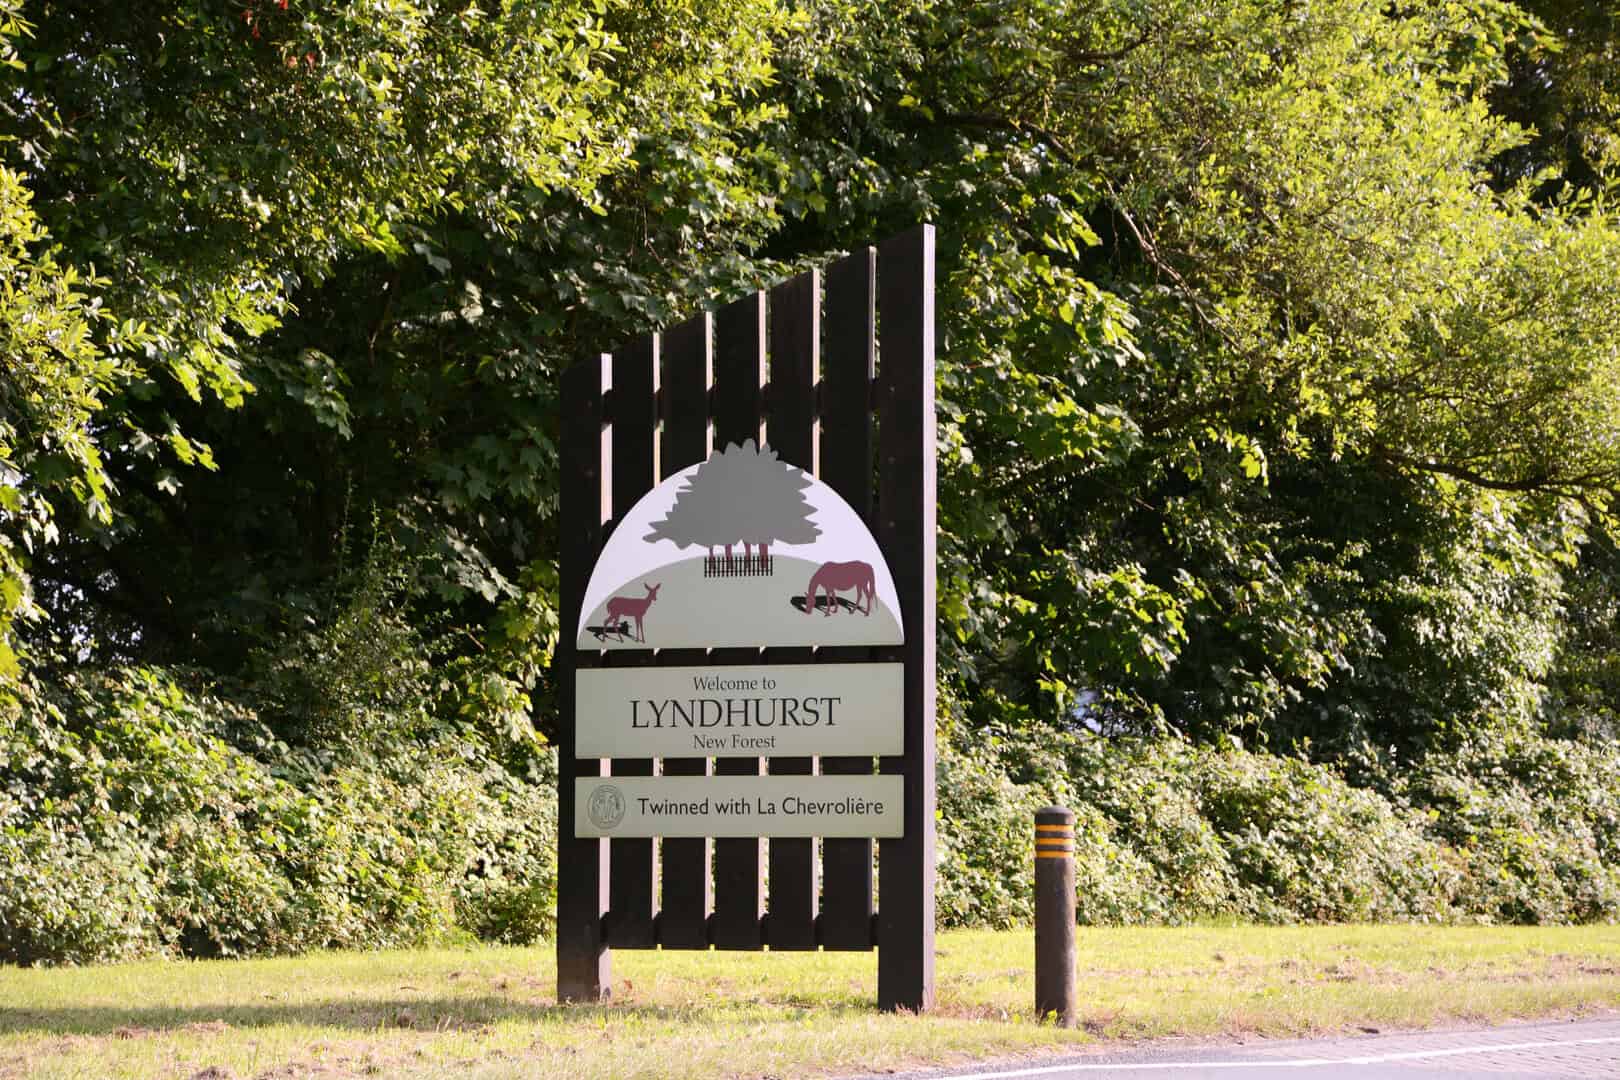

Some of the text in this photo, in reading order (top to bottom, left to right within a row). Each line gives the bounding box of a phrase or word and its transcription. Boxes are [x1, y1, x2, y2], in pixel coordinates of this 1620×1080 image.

[693, 676, 776, 690] Welcome to
[629, 697, 841, 728] LYNDHURST
[693, 734, 776, 749] New Forest
[637, 798, 709, 815] Twinned
[715, 797, 750, 815] with
[758, 798, 776, 815] La
